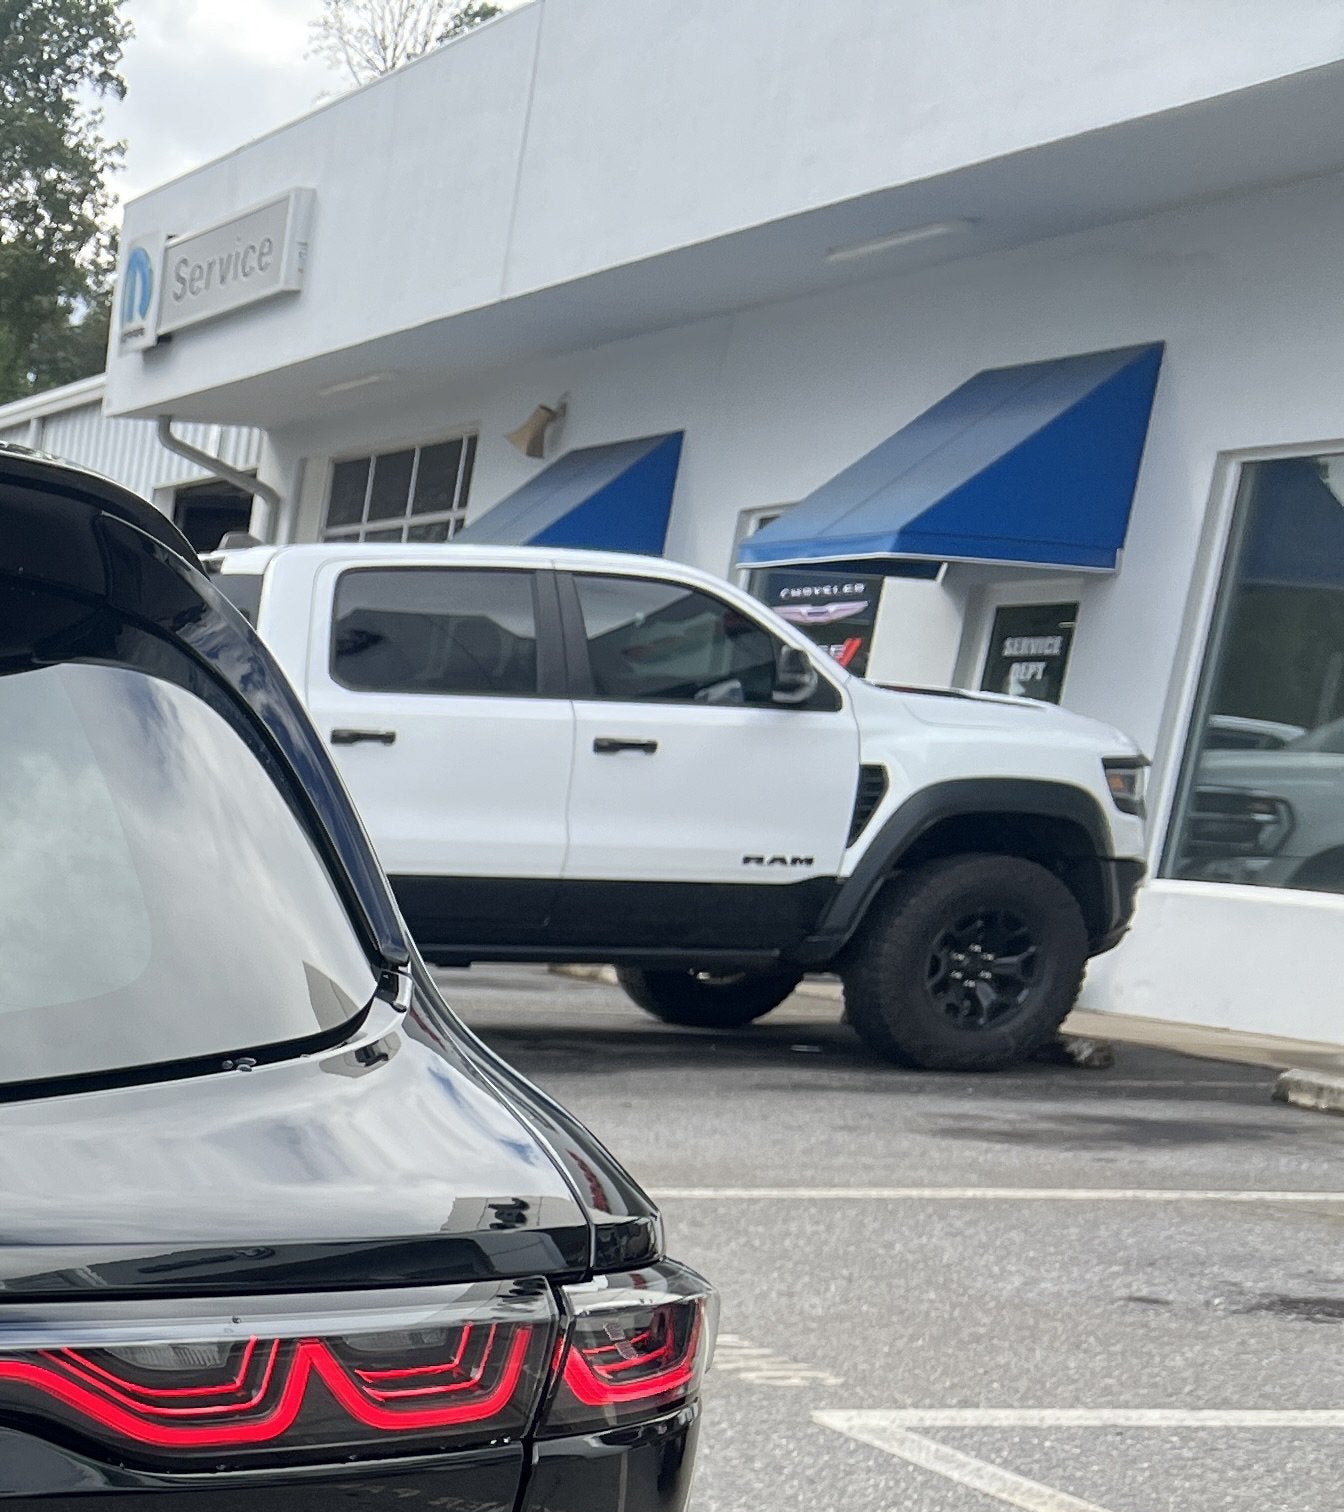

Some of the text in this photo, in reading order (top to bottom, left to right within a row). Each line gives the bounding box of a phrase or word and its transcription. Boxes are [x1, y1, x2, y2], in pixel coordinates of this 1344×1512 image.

[173, 237, 274, 303] Service
[1003, 635, 1062, 657] SERVICE
[742, 856, 814, 866] RAM
